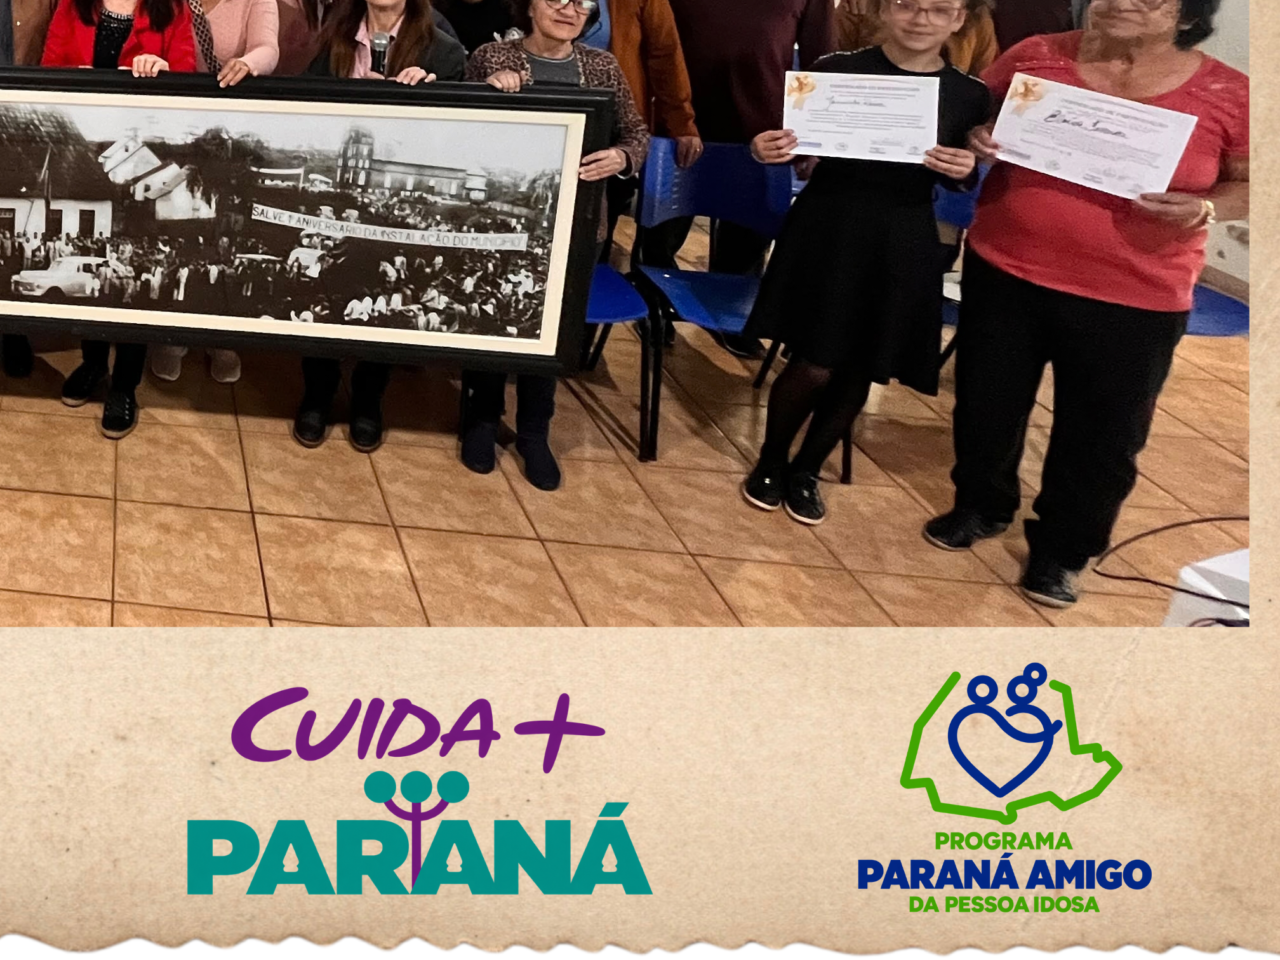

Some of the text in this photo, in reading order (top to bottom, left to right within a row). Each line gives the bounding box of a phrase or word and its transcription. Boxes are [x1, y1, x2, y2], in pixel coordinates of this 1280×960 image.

[252, 205, 284, 222] SALVE
[363, 227, 378, 238] DA
[452, 235, 469, 247] DO
